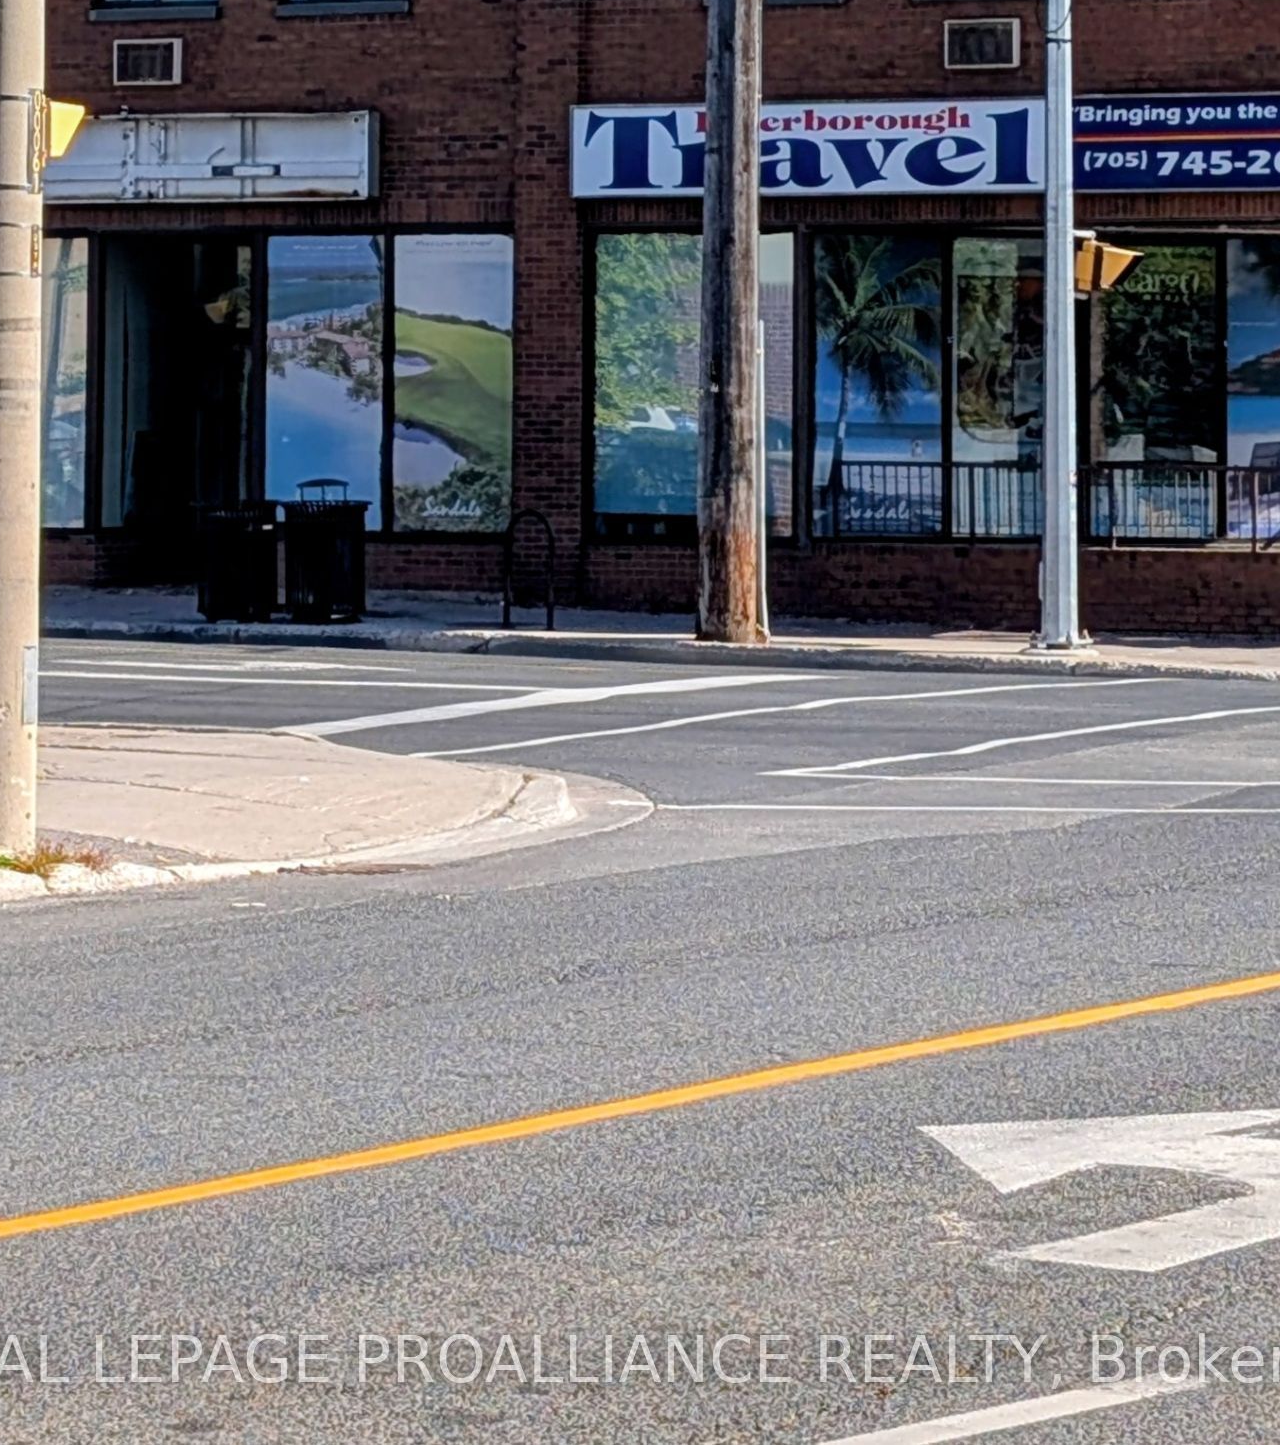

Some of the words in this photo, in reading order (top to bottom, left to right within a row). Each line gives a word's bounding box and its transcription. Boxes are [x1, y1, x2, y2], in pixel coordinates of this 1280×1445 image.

[696, 105, 971, 135] erborough
[1186, 104, 1232, 124] you
[1237, 103, 1278, 119] the
[1083, 150, 1148, 172] (705)
